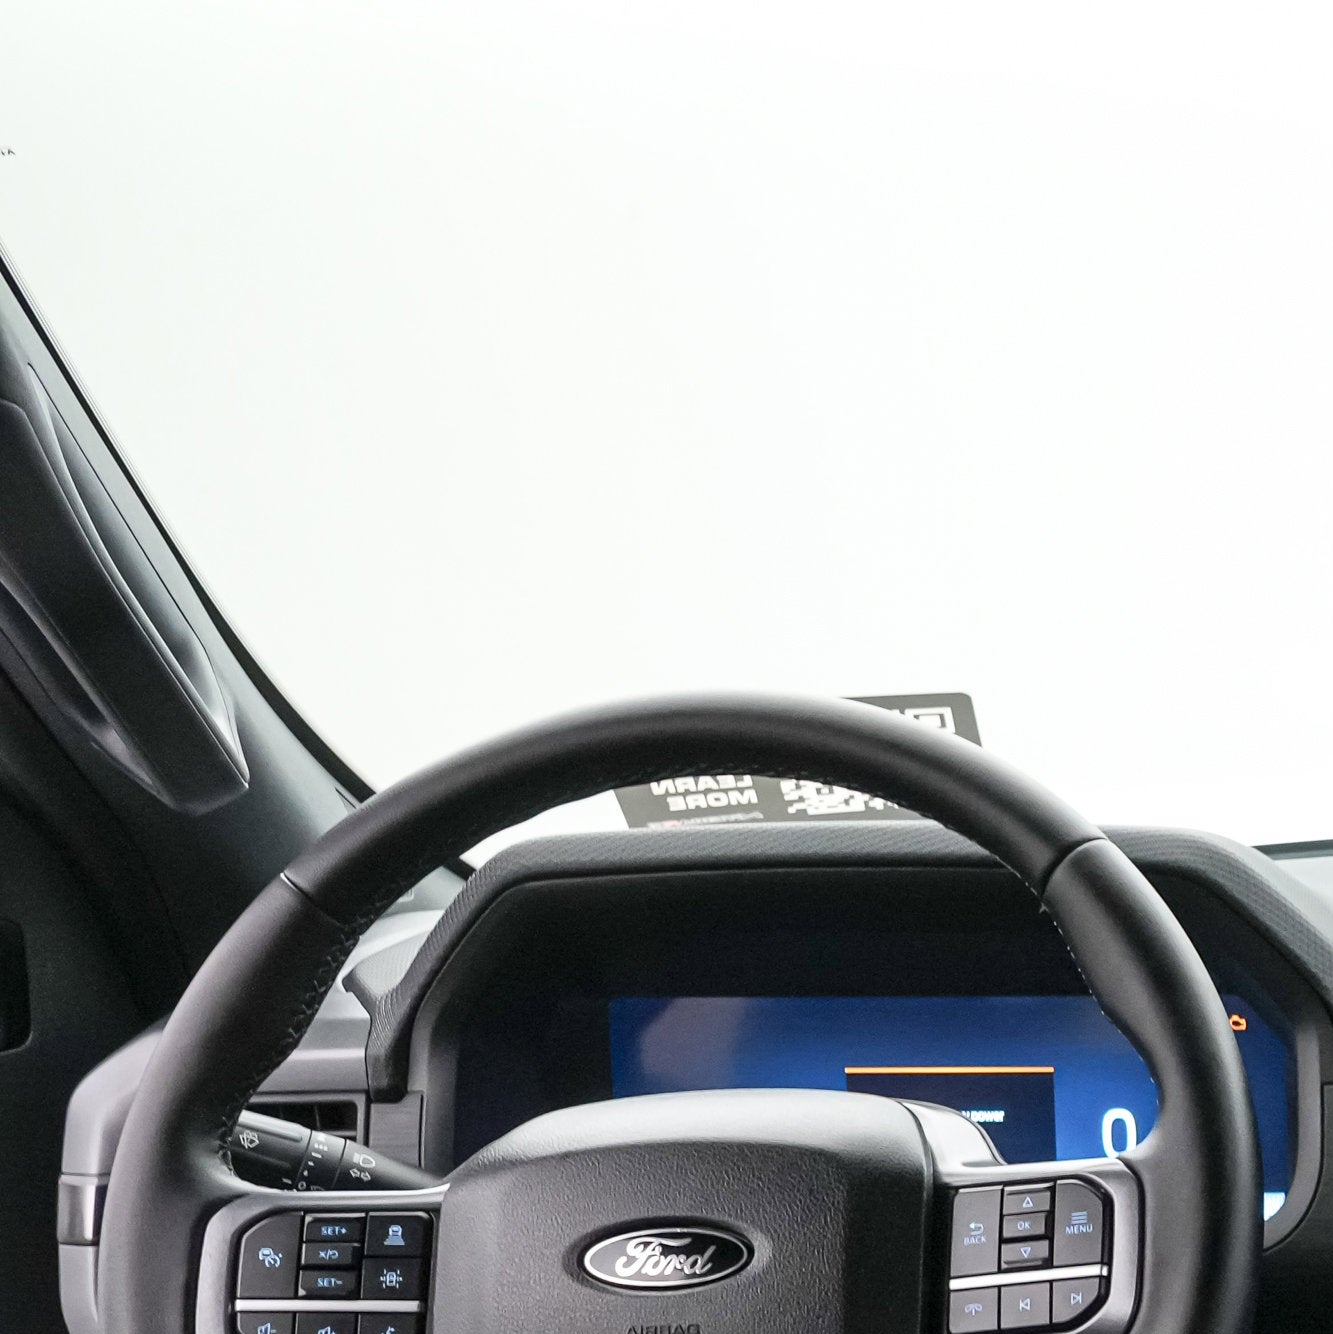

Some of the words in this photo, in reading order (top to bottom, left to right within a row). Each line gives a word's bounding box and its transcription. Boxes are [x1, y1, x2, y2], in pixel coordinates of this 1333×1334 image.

[1101, 1107, 1138, 1159] 0
[1017, 1220, 1031, 1231] OK
[1065, 1223, 1093, 1235] MENU
[963, 1235, 987, 1246] BACK
[614, 1236, 717, 1277] Ford
